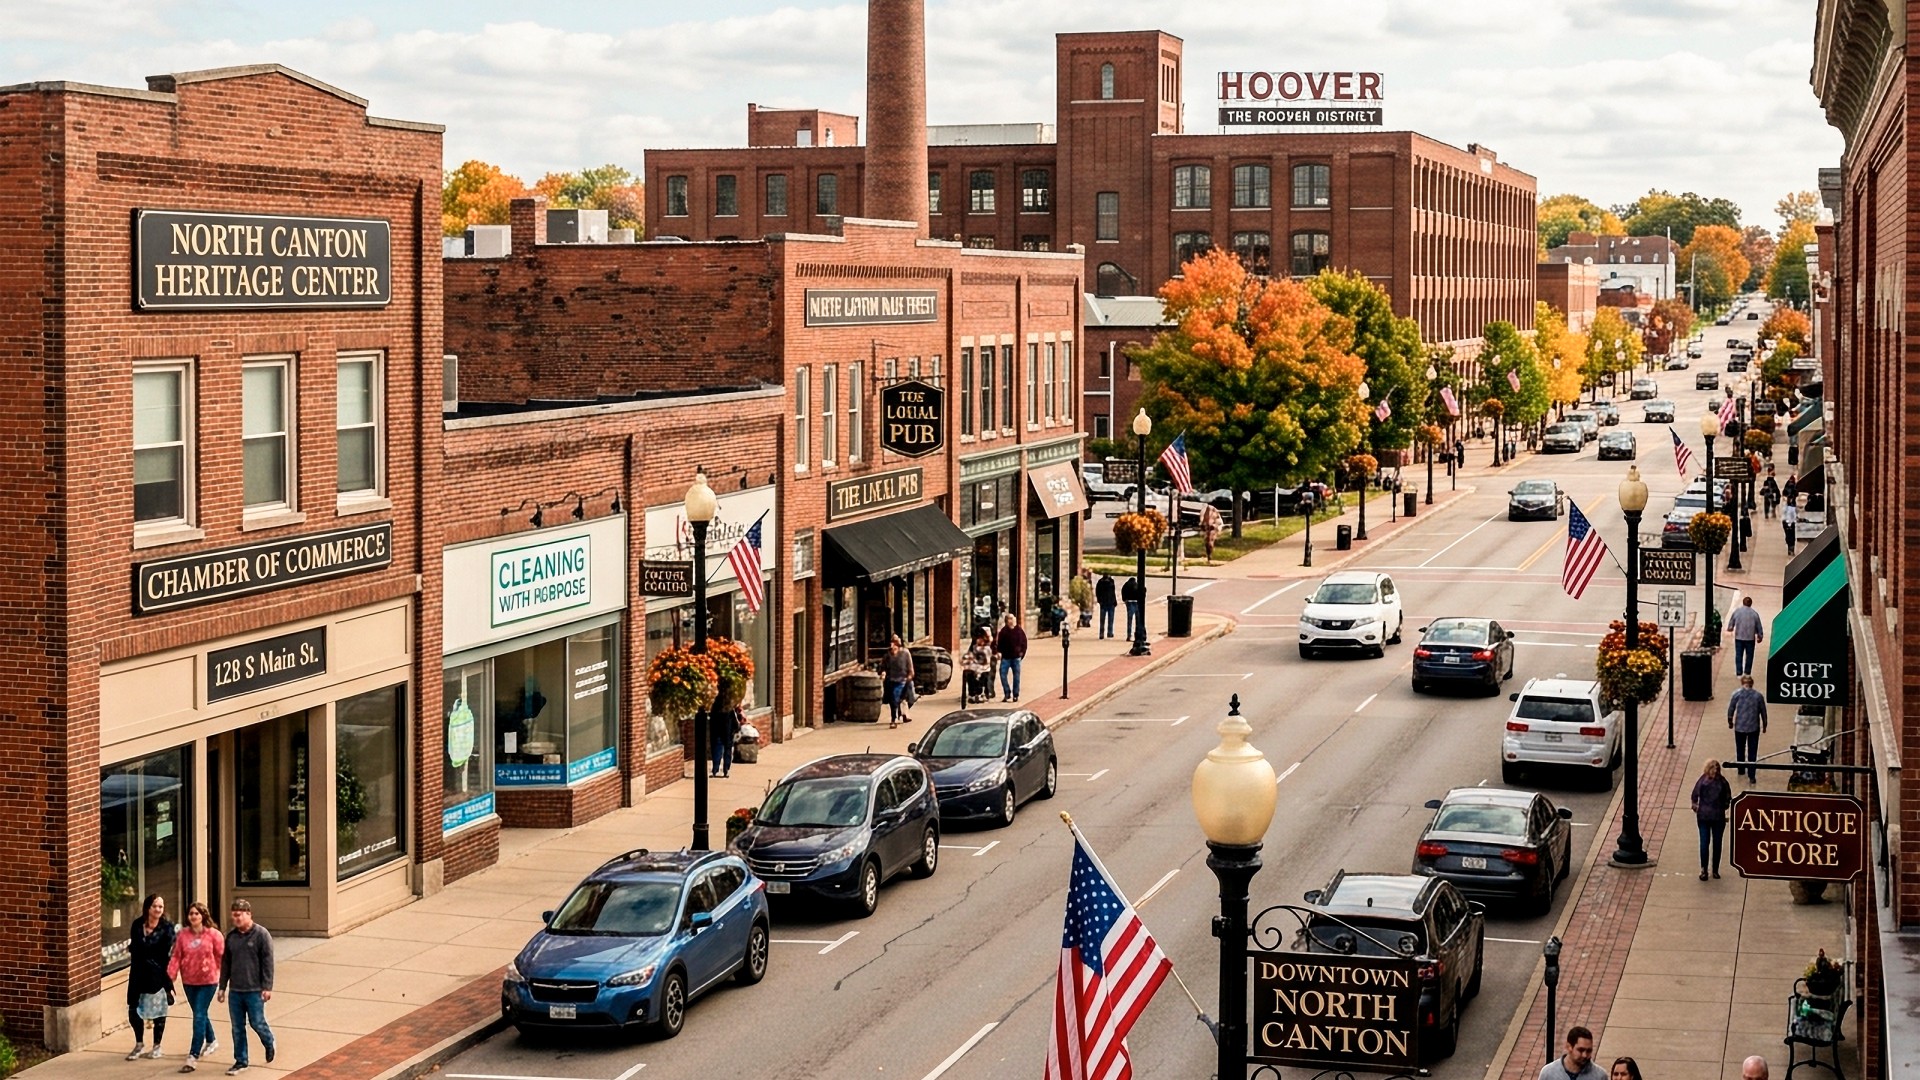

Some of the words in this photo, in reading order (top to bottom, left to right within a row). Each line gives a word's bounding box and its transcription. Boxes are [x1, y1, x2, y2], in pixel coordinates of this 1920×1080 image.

[1220, 71, 1382, 101] HOOVER
[170, 223, 264, 256] NORTH
[270, 226, 367, 258] CANTON
[155, 264, 284, 297] HERITAGE
[291, 266, 380, 296] CENTER
[889, 423, 935, 444] PUB
[148, 557, 250, 600] CHAMBER
[255, 552, 281, 579] OF
[285, 532, 386, 572] COMMERCE
[498, 547, 584, 590] CLEANING
[245, 655, 255, 679] S
[260, 647, 296, 676] Main
[1783, 662, 1832, 679] GIFT
[1780, 682, 1835, 699] SHOP
[1737, 808, 1857, 838] ANTIQUE
[1757, 840, 1839, 866] STORE
[1260, 961, 1409, 988] DOWNTOWN
[1272, 988, 1397, 1022] NORTH
[1262, 1021, 1410, 1057] CANTON
